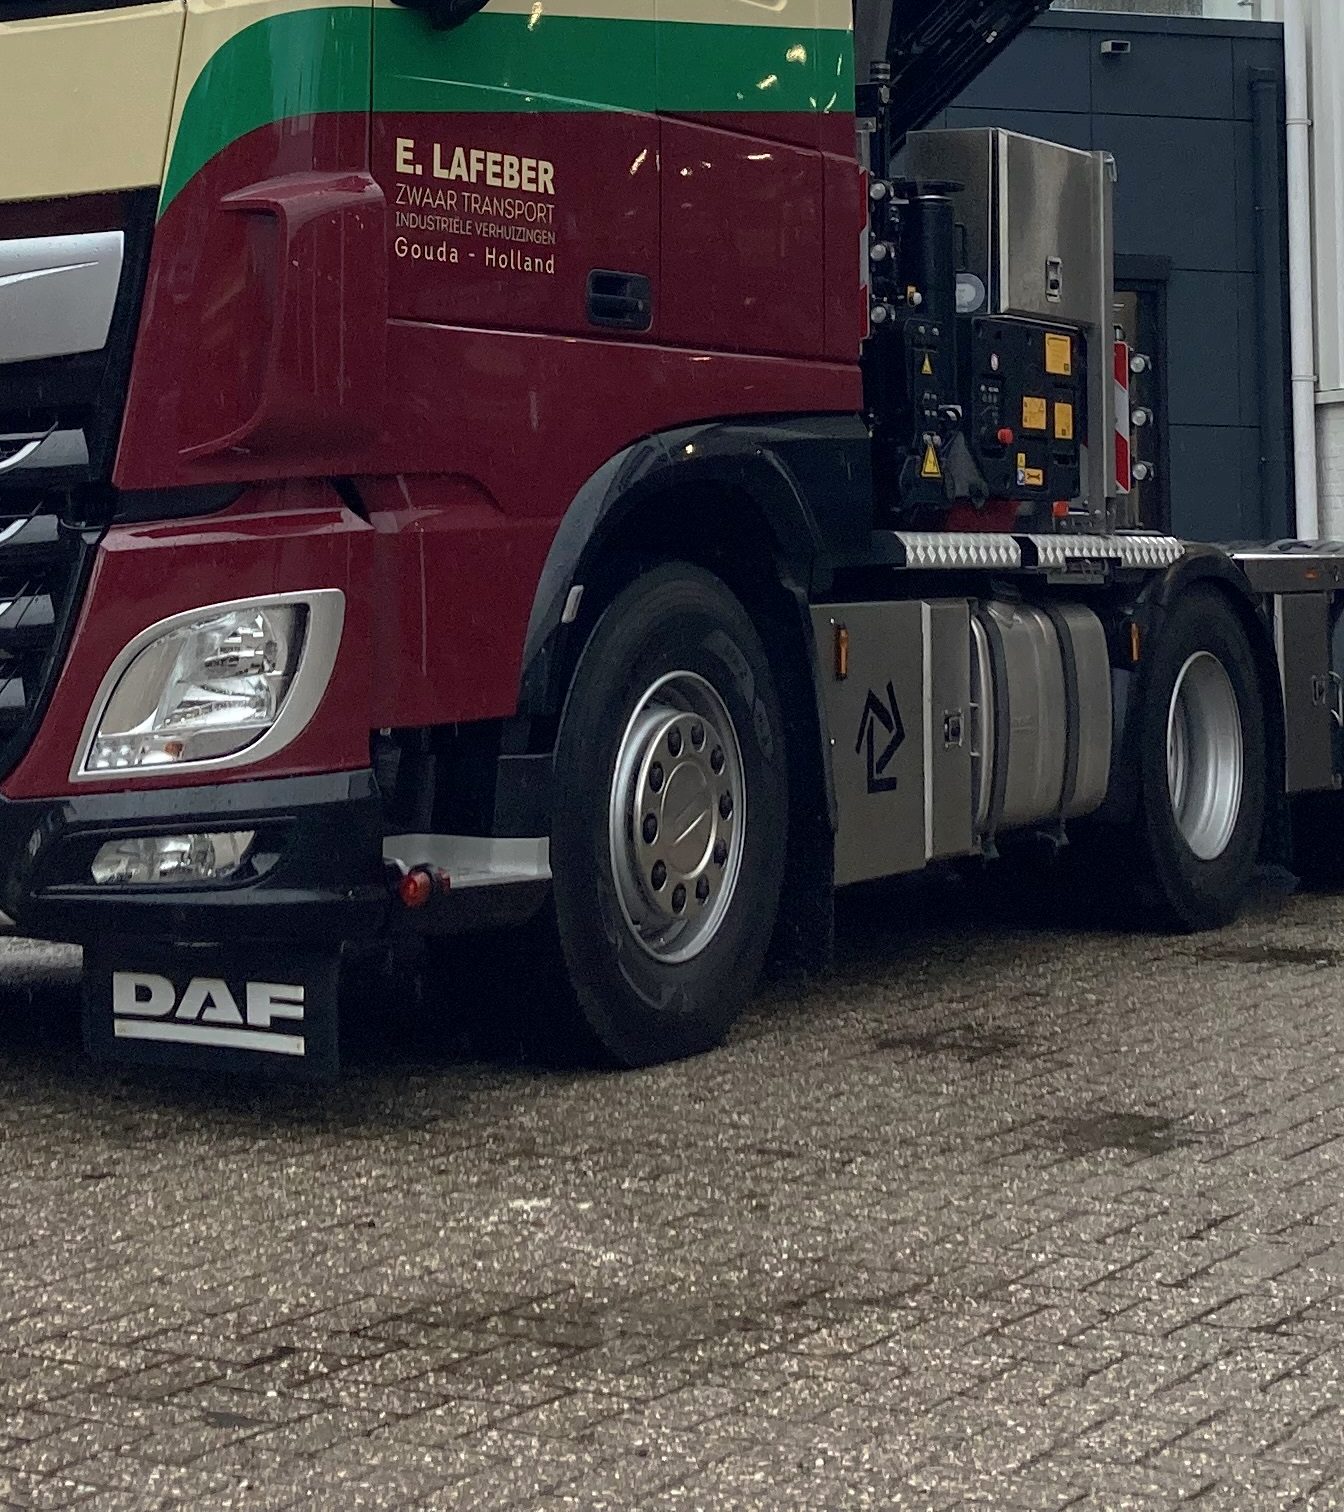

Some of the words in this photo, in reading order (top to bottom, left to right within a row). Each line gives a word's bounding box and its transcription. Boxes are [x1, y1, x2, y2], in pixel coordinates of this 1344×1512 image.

[396, 137, 423, 175] E.
[433, 143, 555, 195] LAFEBER
[395, 183, 457, 210] ZWAAR
[462, 192, 555, 225] TRANSPORT
[475, 219, 556, 245] VERHUIZINGEN
[395, 237, 459, 263] Gouda
[485, 246, 555, 274] Holland
[113, 971, 305, 1028] DAF
